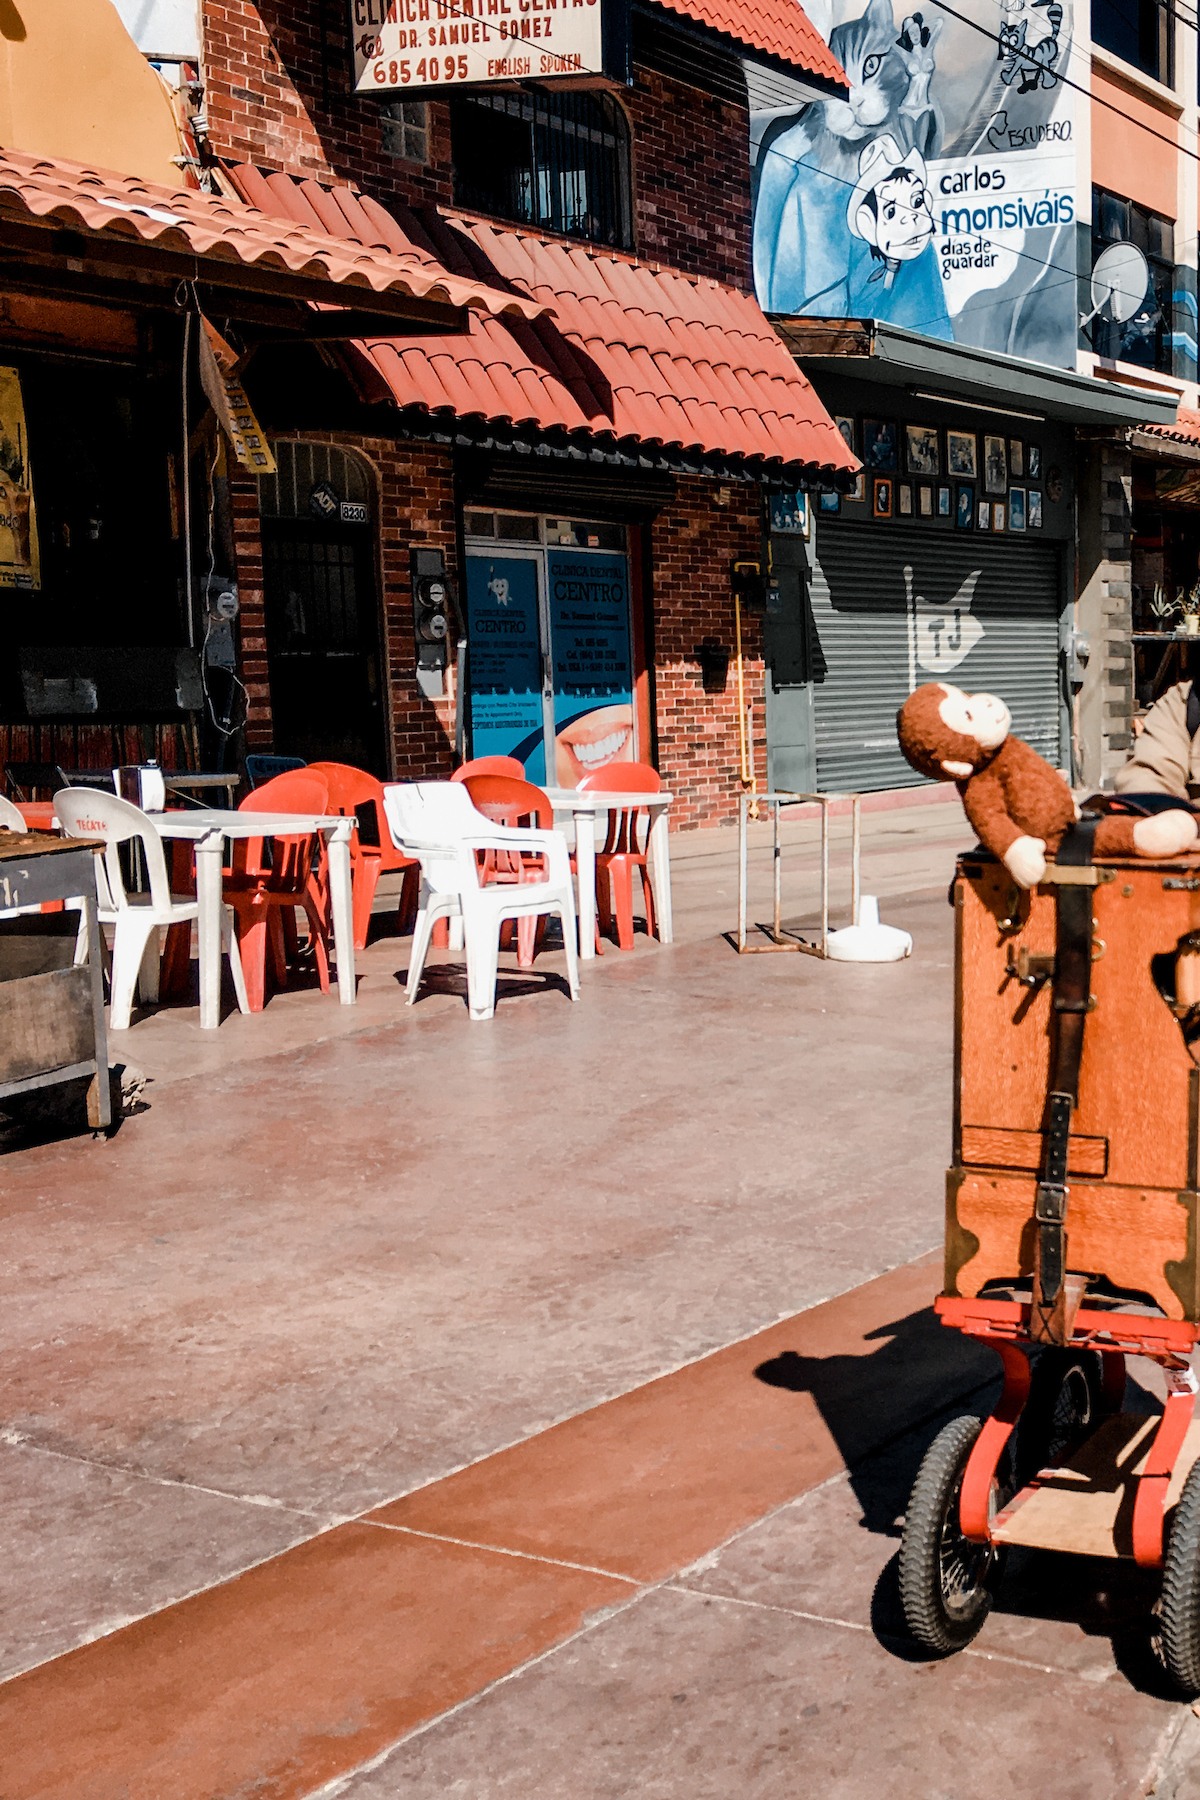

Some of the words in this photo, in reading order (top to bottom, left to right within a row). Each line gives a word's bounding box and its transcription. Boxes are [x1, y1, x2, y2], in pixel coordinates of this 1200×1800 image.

[354, 0, 430, 26] CLINICA
[399, 28, 422, 49] DR.
[428, 22, 490, 47] SAMUEL
[499, 16, 552, 41] GOMEZ
[488, 57, 531, 77] ENGLISH
[540, 53, 581, 73] SPOKEN
[939, 165, 1006, 195] carlos
[941, 189, 1074, 235] monsiváis
[974, 236, 991, 253] de
[942, 254, 999, 280] guardar
[313, 490, 337, 513] ADT
[551, 564, 590, 577] CLINICA
[590, 566, 624, 579] DENTAL
[554, 580, 624, 603] CENTRO
[475, 619, 526, 634] CENTRO
[928, 608, 961, 657] TJ
[75, 819, 108, 832] TECATE
